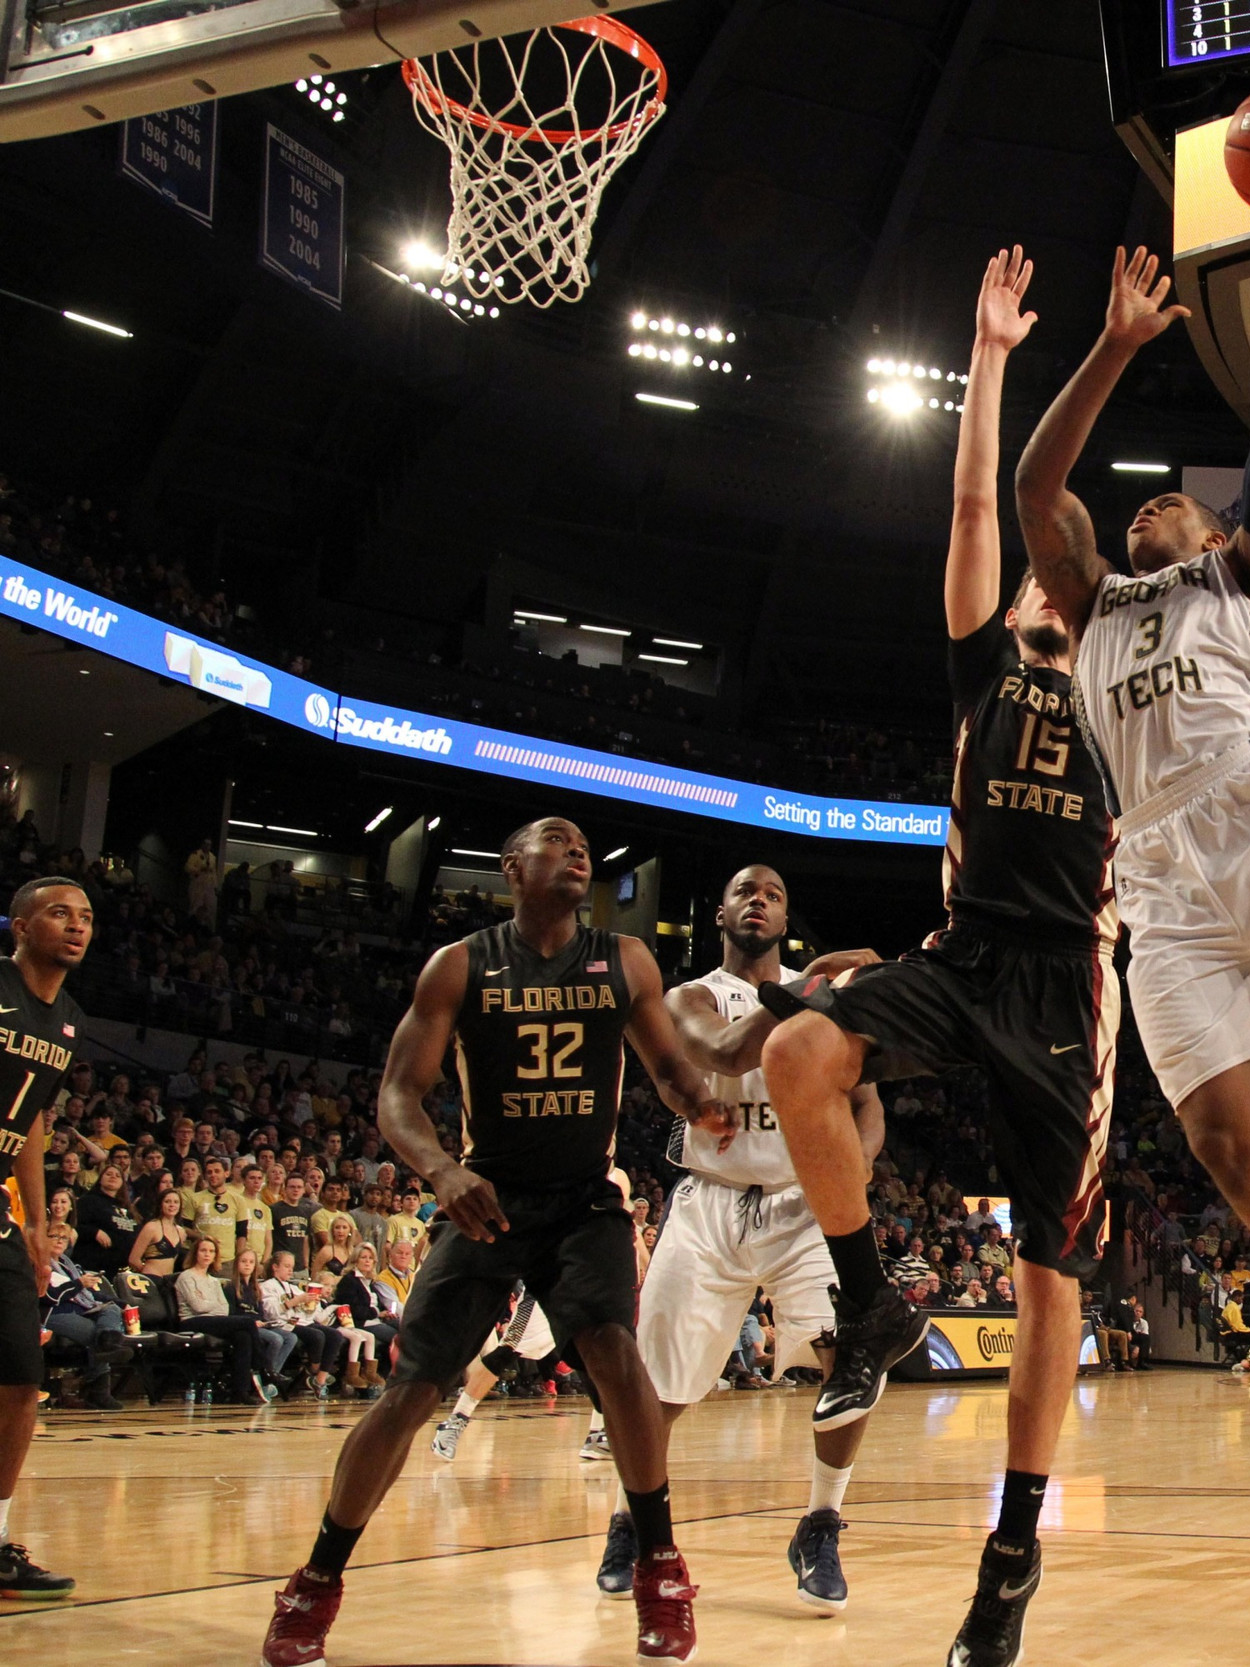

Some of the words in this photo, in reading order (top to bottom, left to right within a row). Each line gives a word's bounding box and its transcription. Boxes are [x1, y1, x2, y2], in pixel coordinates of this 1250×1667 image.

[1192, 6, 1203, 22] 3
[1192, 23, 1203, 39] 4
[1223, 19, 1231, 34] 1
[1190, 40, 1208, 57] 10
[1224, 36, 1231, 51] 1
[141, 117, 169, 148] 1986
[175, 114, 201, 145] 1996
[140, 142, 168, 173] 1990
[173, 139, 202, 171] 2004
[289, 175, 319, 210] 1985
[289, 205, 319, 240] 1990
[289, 234, 321, 271] 2004
[3, 575, 42, 610] the
[1135, 610, 1165, 660] 3
[1106, 655, 1203, 721] TECH
[330, 705, 453, 755] Suddath
[1015, 712, 1071, 778] 15
[764, 795, 821, 831] Setting
[826, 807, 856, 829] the
[861, 808, 942, 836] Standard
[987, 779, 1084, 821] STATE
[481, 984, 617, 1014] FLORIDA
[516, 1022, 584, 1079] 32
[6, 1070, 36, 1121] 1
[501, 1089, 595, 1117] STATE
[738, 1101, 777, 1132] TE
[286, 1229, 306, 1238] TECH
[977, 1325, 1015, 1363] Contin
